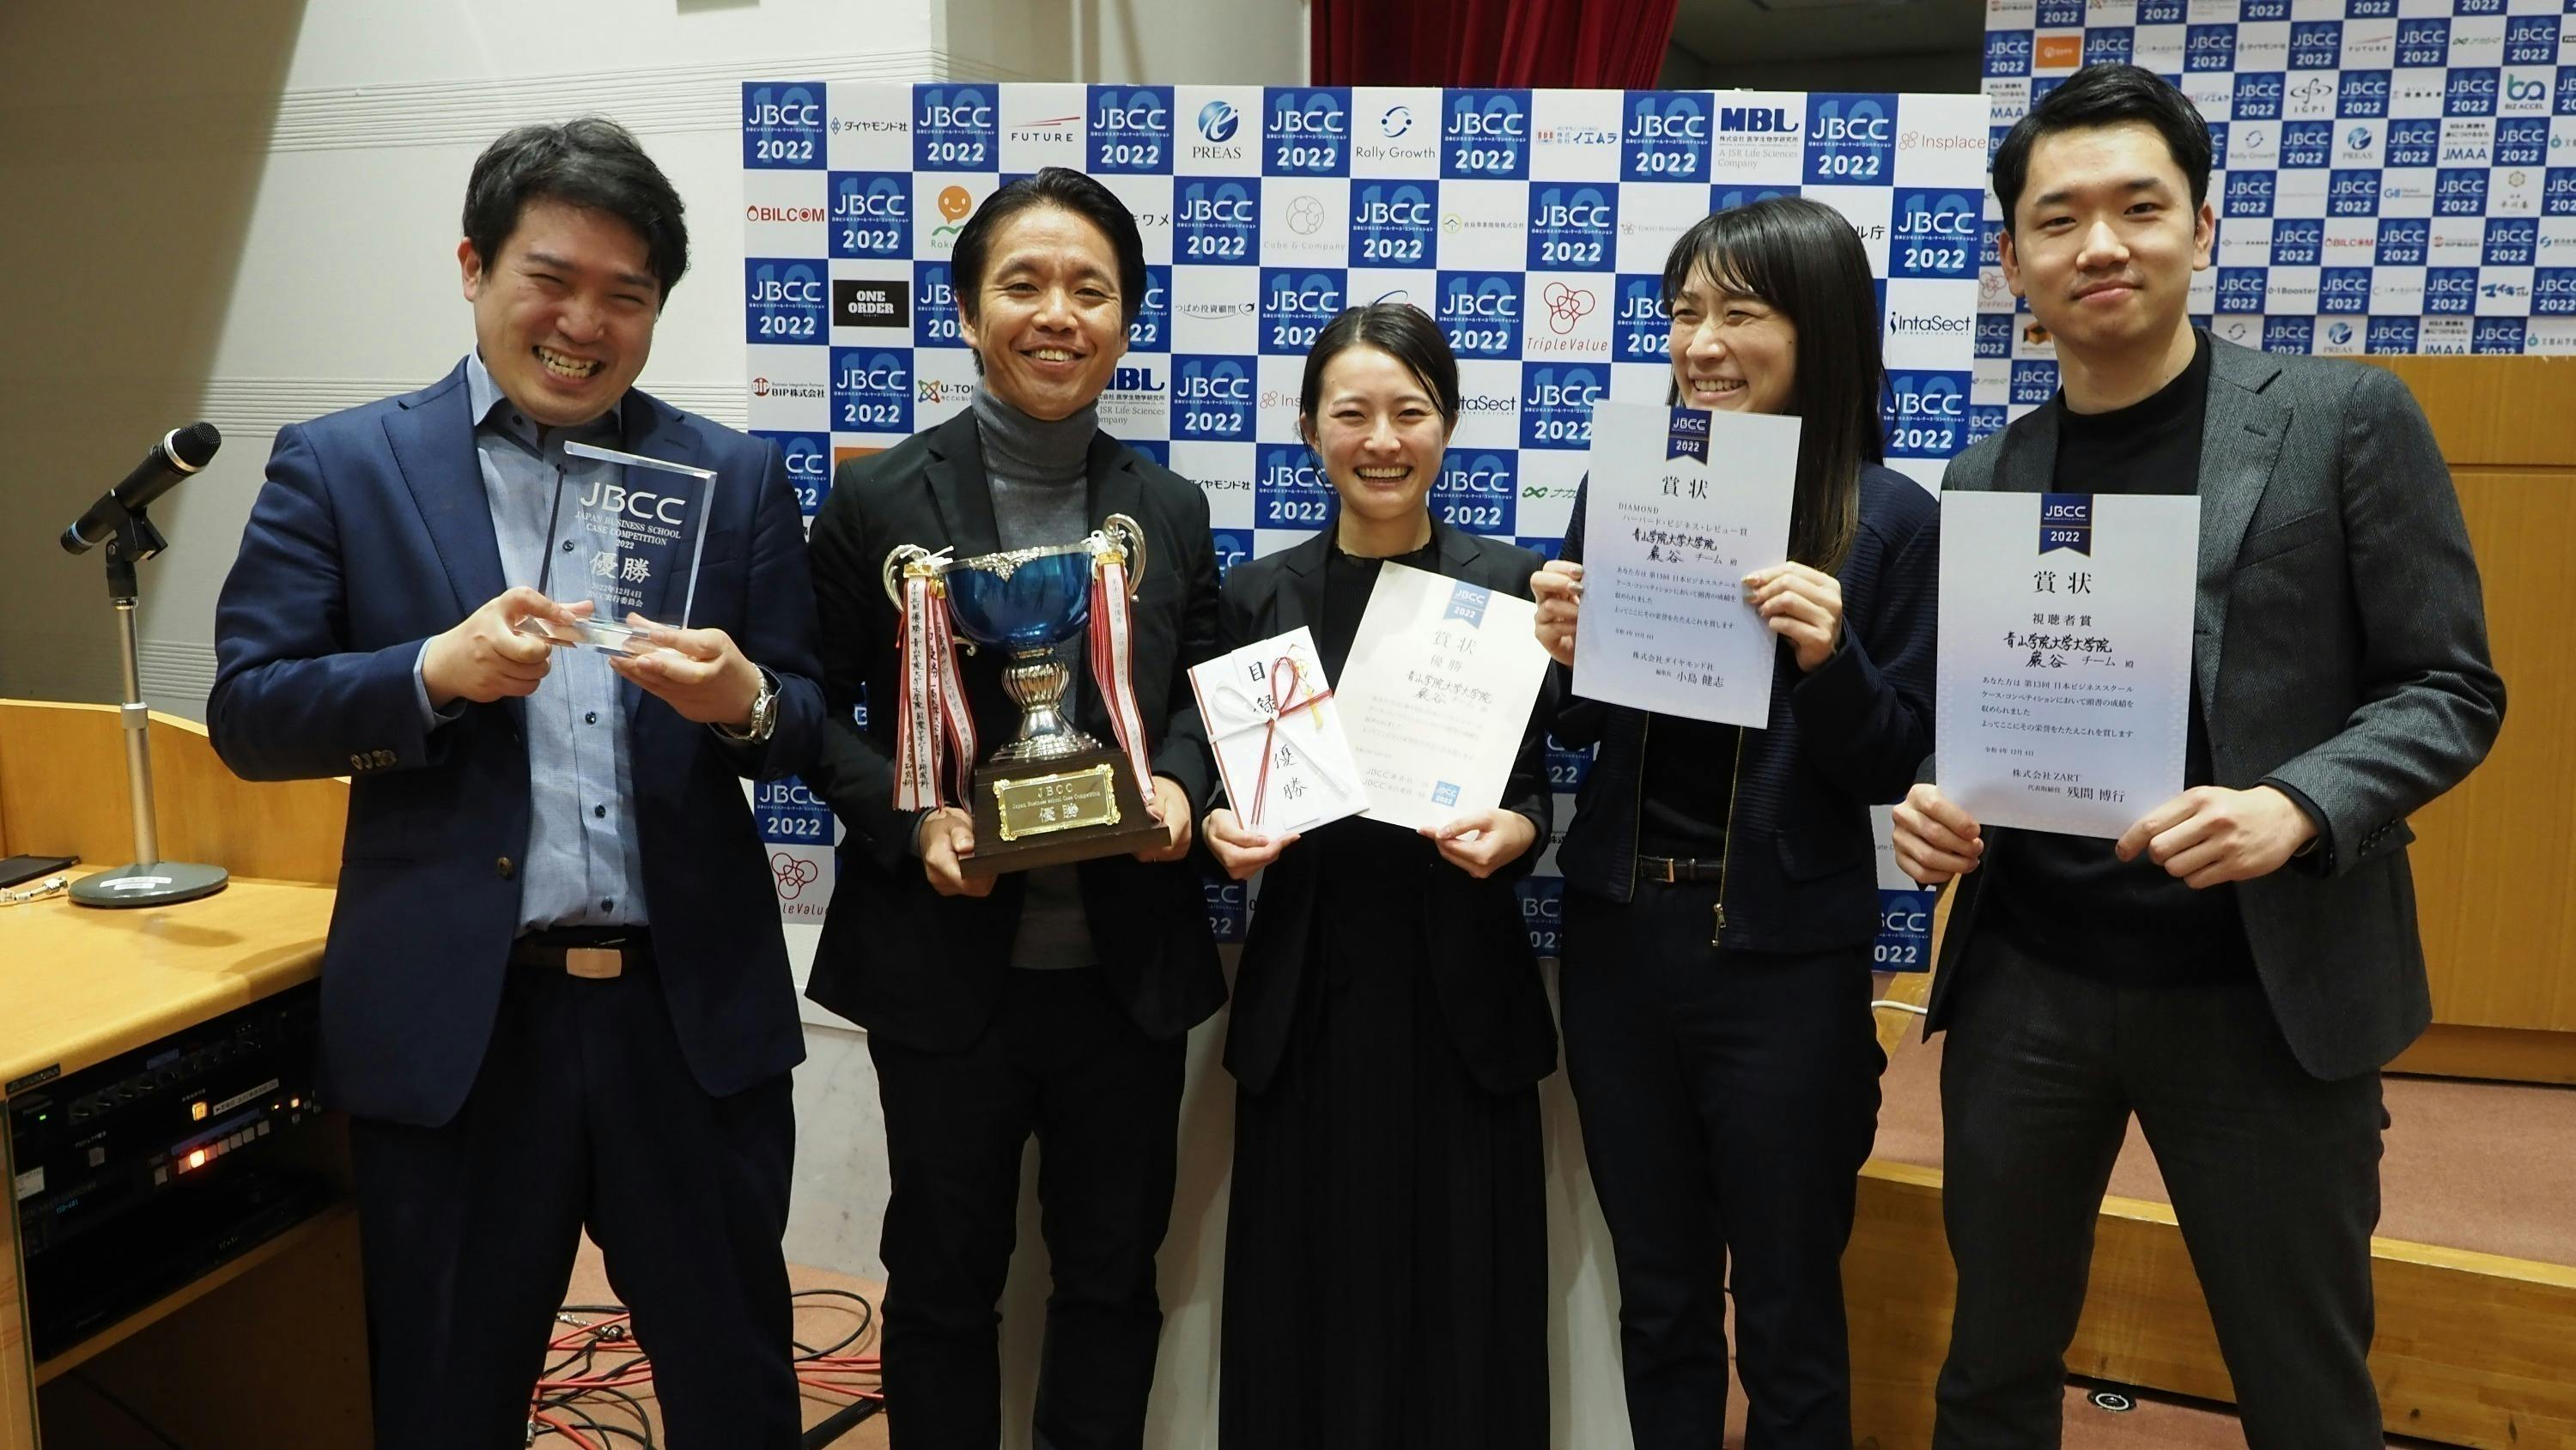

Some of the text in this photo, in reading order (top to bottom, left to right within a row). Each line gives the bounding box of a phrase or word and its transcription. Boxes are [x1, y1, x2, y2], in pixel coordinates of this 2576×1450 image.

[2293, 32, 2338, 47] JBCC
[2508, 27, 2556, 42] JBCC
[1987, 40, 2030, 56] JBCC
[2512, 47, 2549, 61] 2022
[1990, 60, 2025, 74] 2022
[2296, 52, 2332, 65] 2022
[748, 104, 819, 125] JBCC
[919, 106, 992, 128] JBCC
[1269, 110, 1344, 132] JBCC
[1720, 107, 1799, 132] MBL
[1990, 107, 2024, 118] MAA
[844, 120, 908, 132] ダイヤモンド社
[1448, 112, 1524, 135] JBCC
[1629, 115, 1705, 137] JBCC
[1812, 118, 1889, 140] JBCC
[1011, 132, 1074, 142] FUTURE
[1922, 133, 1986, 150] Insplace
[2283, 131, 2330, 146] JBCC
[756, 139, 813, 160] 2022
[927, 142, 984, 162] 2022
[1193, 147, 1242, 159] PREAS
[1277, 147, 1336, 167] 2022
[1356, 146, 1436, 161] Rally Growth
[2287, 151, 2324, 164] 2022
[2443, 148, 2487, 161] JMAA
[1455, 149, 1515, 170] 2022
[1635, 151, 1696, 173] 2022
[1718, 159, 1758, 169] Company
[1818, 155, 1880, 176] 2022
[2227, 181, 2272, 196] JBCC
[835, 194, 906, 215] JBCC
[2231, 201, 2267, 214] 2022
[761, 208, 825, 222] BILCOM
[1356, 203, 1431, 225] JBCC
[1898, 211, 1976, 234] JBCC
[842, 229, 899, 250] 2022
[1856, 225, 1886, 240] ル庁
[1264, 241, 1286, 251] Cube
[1302, 242, 1346, 252] Company
[1363, 238, 1422, 259] 2022
[1904, 248, 1965, 269] 2022
[751, 281, 822, 302] JBCC
[2427, 278, 2474, 292] JBCC
[856, 290, 886, 302] ONE
[2431, 298, 2468, 311] 2022
[848, 303, 895, 314] ORDER
[759, 315, 815, 335] 2022
[1899, 315, 1971, 331] IntaSect
[836, 369, 907, 391] JBCC
[2014, 370, 2055, 384] JBCC
[1459, 396, 1516, 411] taSect
[1528, 385, 1601, 406] JBCC
[2016, 389, 2050, 401] 2022
[844, 403, 900, 423] 2022
[1116, 406, 1130, 415] Life
[1534, 422, 1592, 440] 2022
[1673, 417, 1707, 431] JBCC
[1675, 440, 1700, 452] 2022
[1261, 467, 1333, 488] JBCC
[1437, 471, 1510, 493] JBCC
[1662, 476, 1709, 500] 賞状
[580, 482, 685, 525] JBCC
[1269, 501, 1327, 520] 2022
[1619, 503, 1659, 514] DIAMOND
[2045, 505, 2087, 518] JBCC
[1443, 506, 1501, 525] 2022
[575, 512, 681, 539] JAPAN BUSINESS SCHOOL
[586, 523, 667, 546] CASE COMPETITION
[617, 539, 635, 549] 2022
[1632, 527, 1717, 551] 青山学院大学大学院
[2050, 531, 2080, 543] 2022
[590, 550, 651, 584] 優勝
[2033, 571, 2092, 594] 賞状
[1455, 589, 1485, 604] JBCC
[1454, 606, 1475, 619] 2022
[2032, 612, 2093, 627] 視聴者賞
[1434, 631, 1477, 655] 賞状
[2003, 631, 2112, 652] 青山学院大学大学院
[1274, 743, 1308, 800] 優勝
[767, 816, 821, 836] 2022
